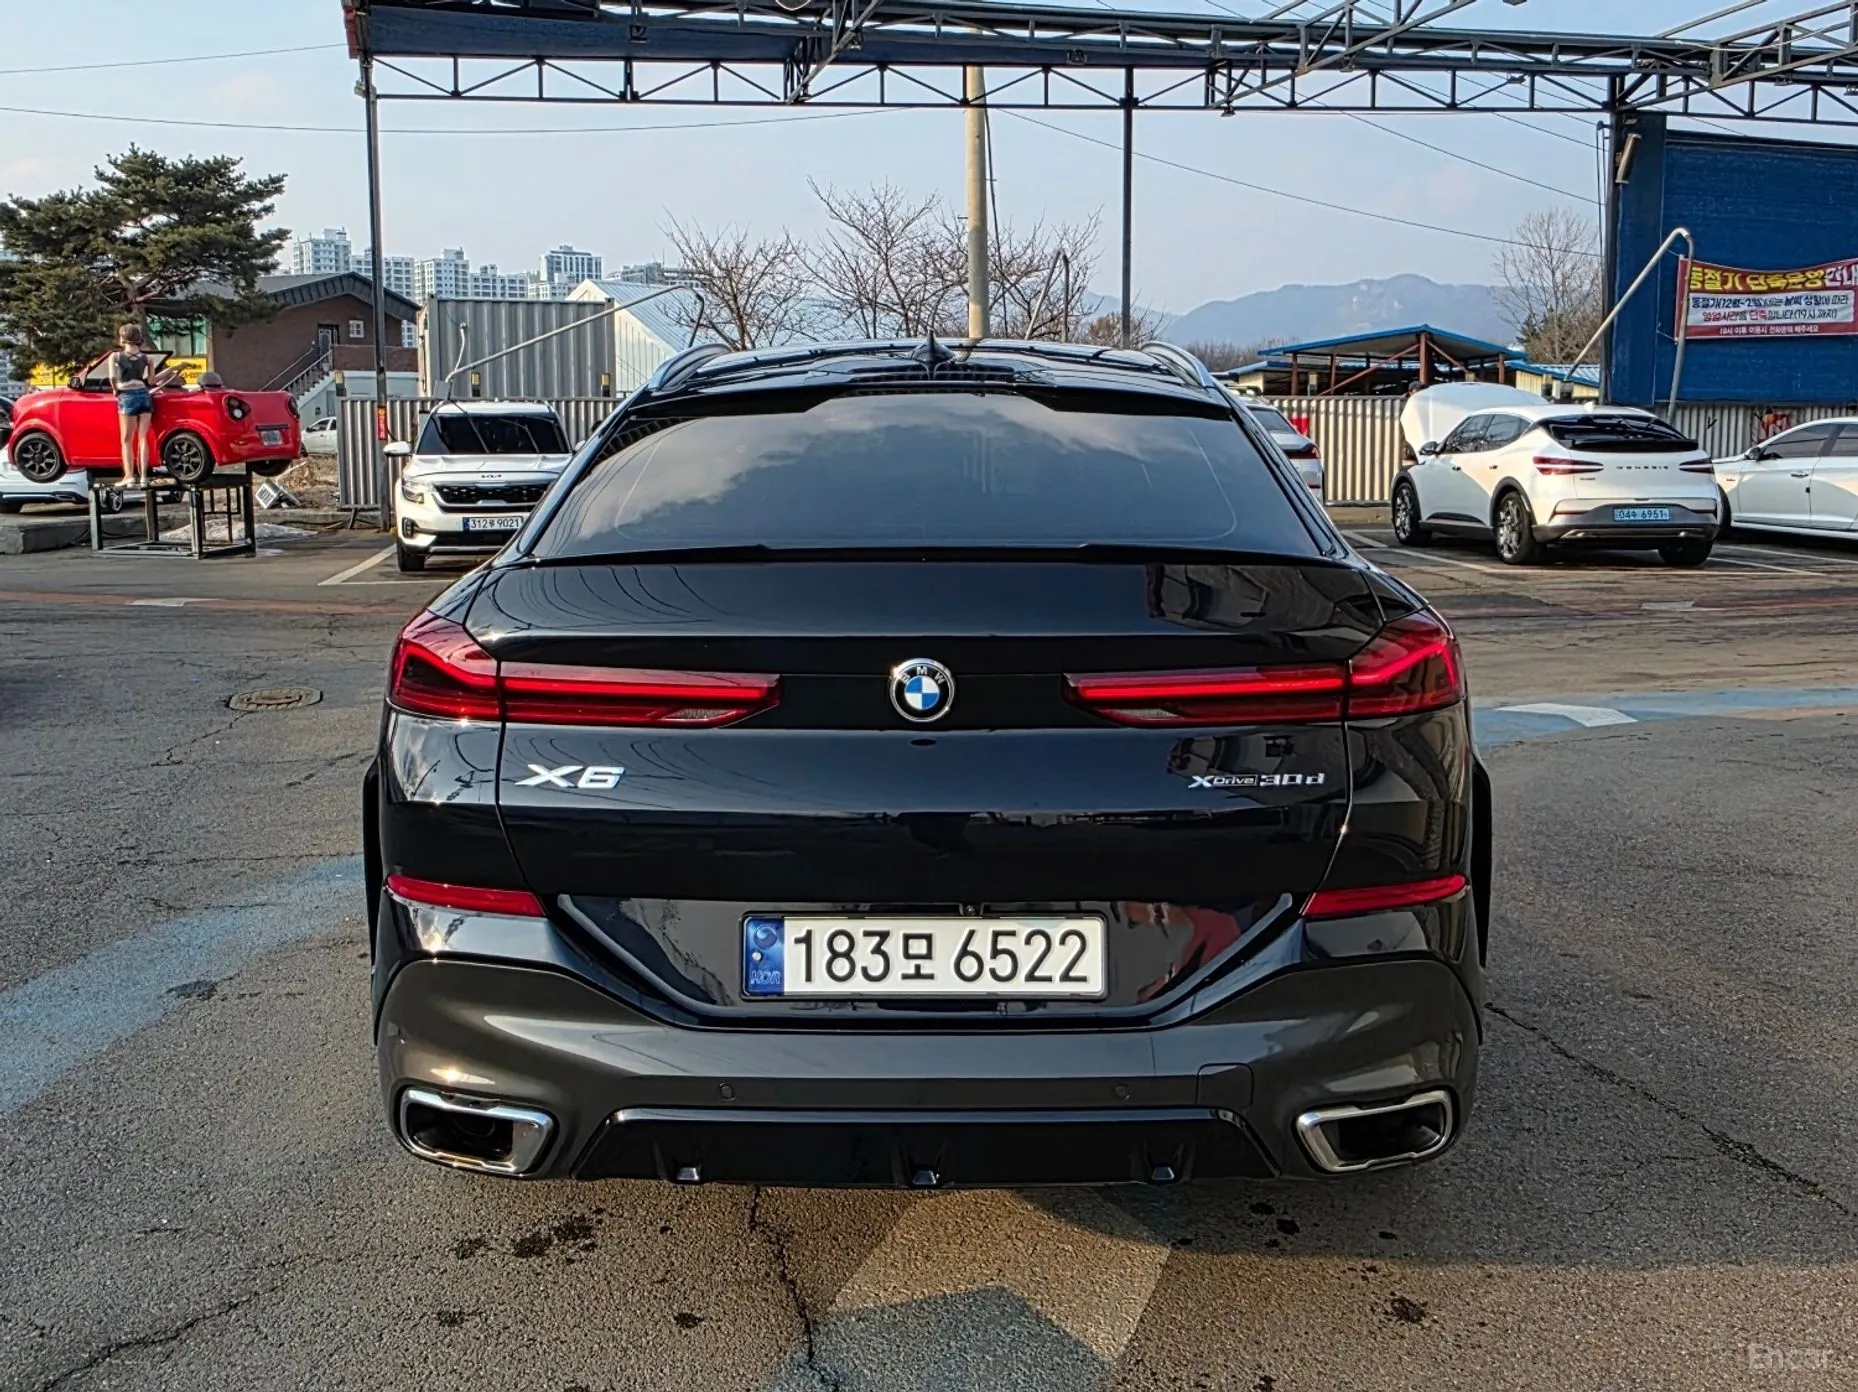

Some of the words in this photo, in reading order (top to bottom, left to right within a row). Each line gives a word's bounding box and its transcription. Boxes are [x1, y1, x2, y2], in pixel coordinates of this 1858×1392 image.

[1690, 266, 1743, 291] 동절기
[496, 518, 519, 528] 9021
[1641, 509, 1664, 519] 6951
[899, 666, 946, 685] BMW
[514, 763, 626, 789] X6
[793, 927, 935, 983] 183모
[952, 927, 1089, 983] 6522
